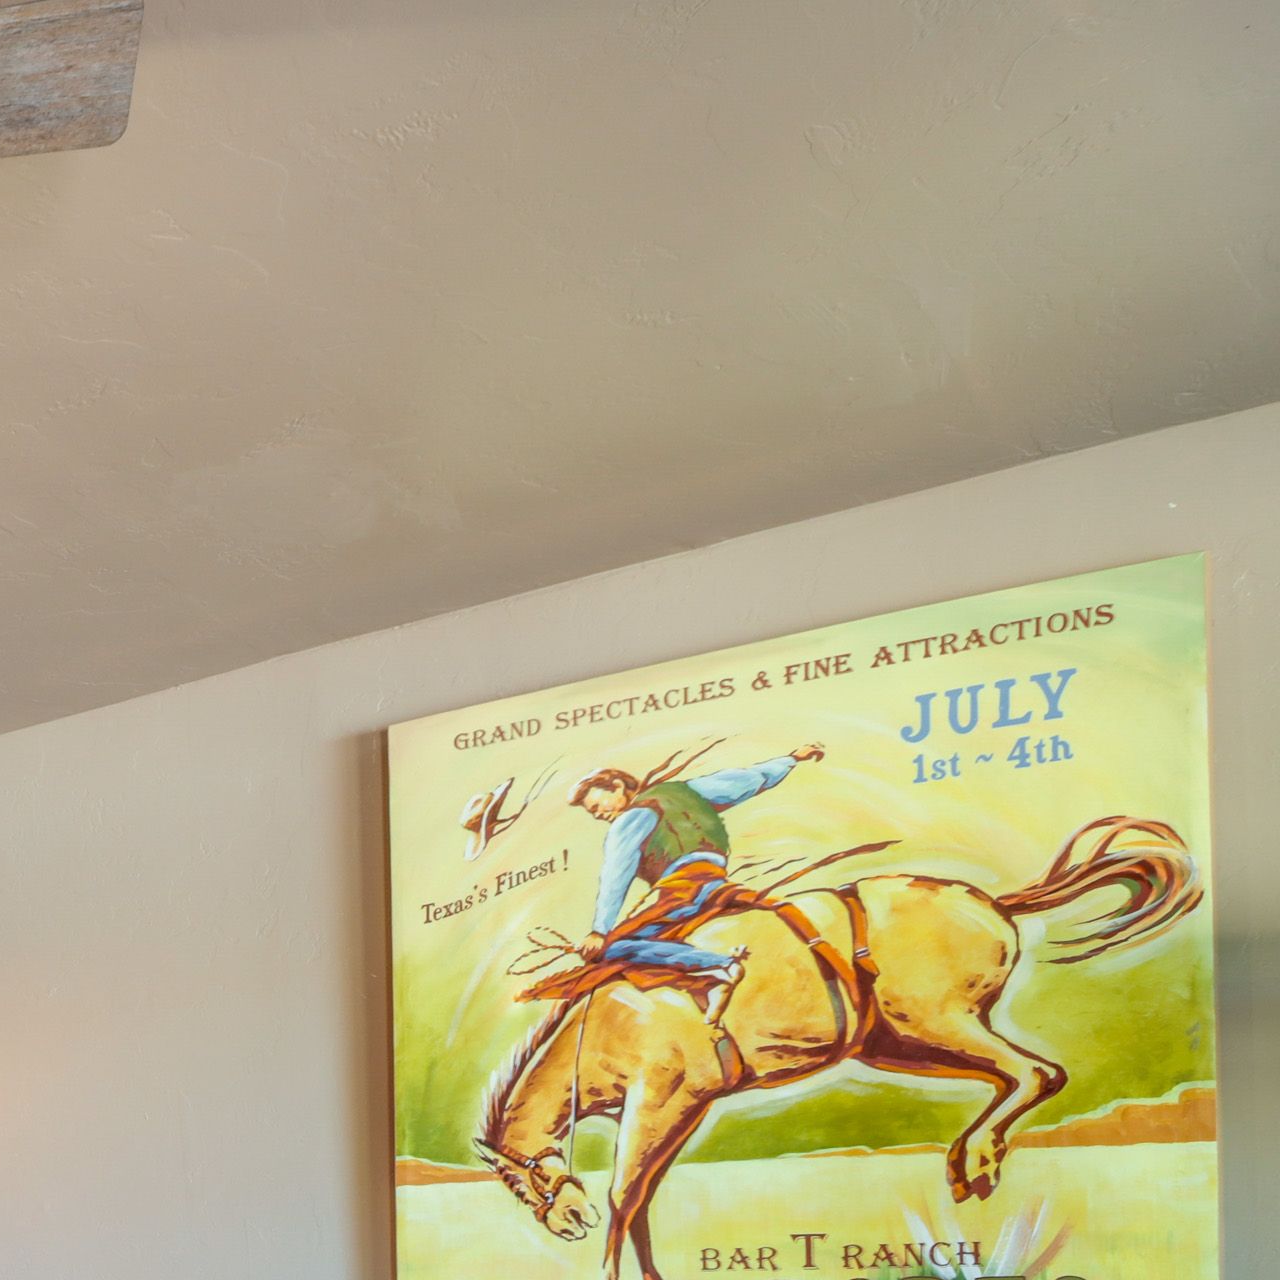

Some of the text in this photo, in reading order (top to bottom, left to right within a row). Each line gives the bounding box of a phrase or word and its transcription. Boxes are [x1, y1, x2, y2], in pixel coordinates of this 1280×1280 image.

[452, 603, 1116, 751] GRAND SPECTACLES & FINE ATTRACTIONS
[900, 668, 1077, 743] JULY
[912, 753, 961, 784] 1st
[1007, 734, 1074, 768] 4th
[421, 884, 488, 925] Texas's
[494, 857, 557, 897] Finest
[700, 1234, 983, 1271] BAR T RANCH
